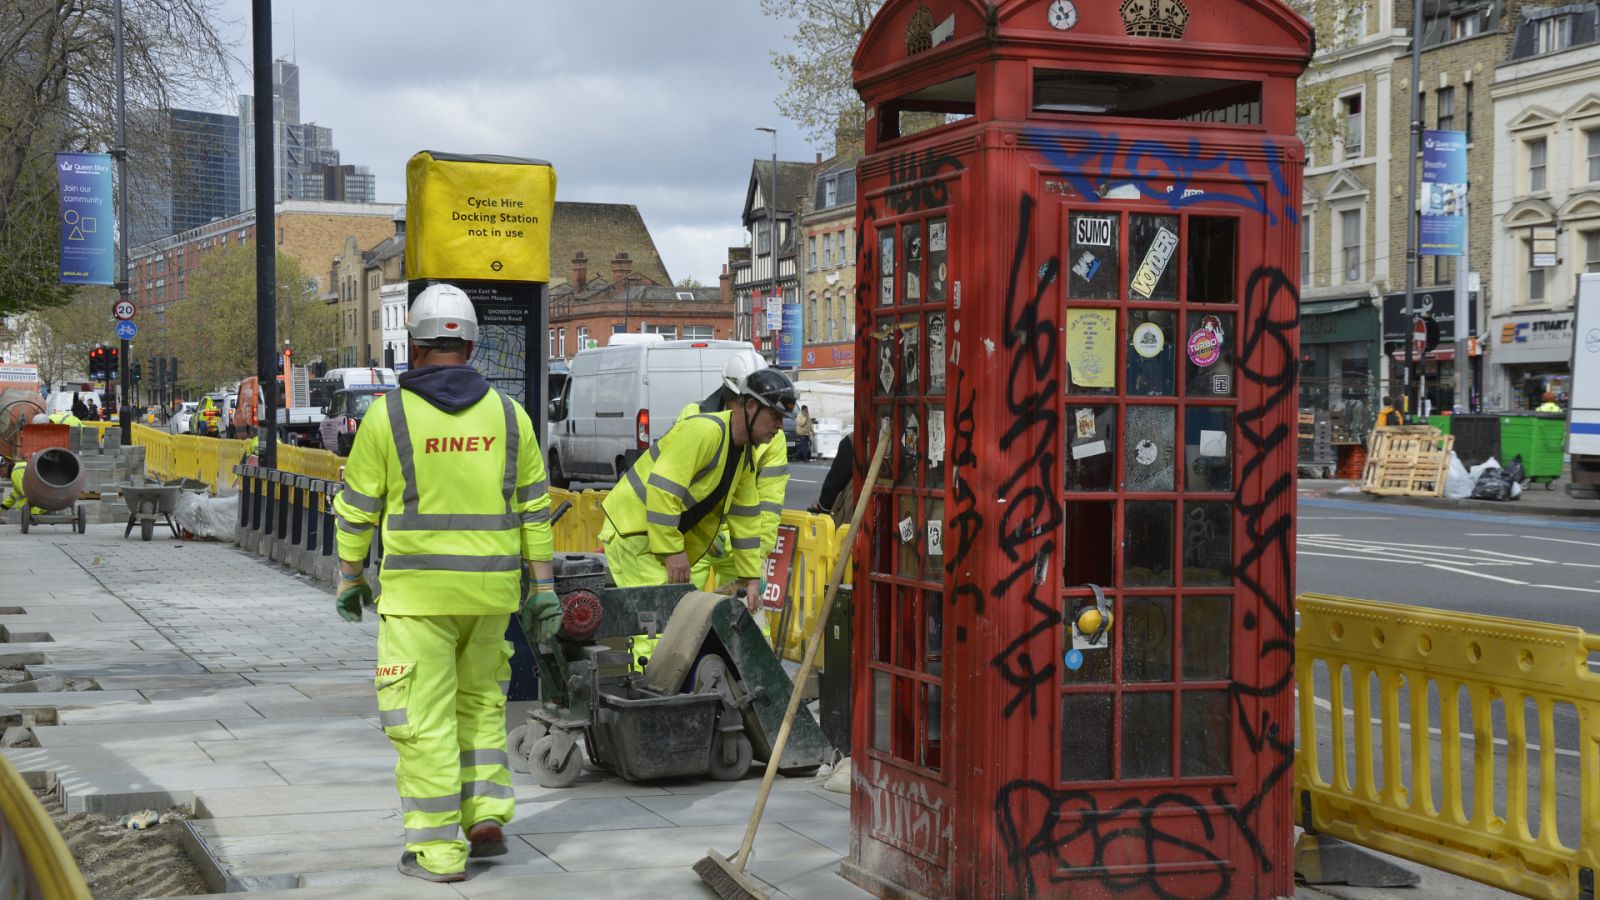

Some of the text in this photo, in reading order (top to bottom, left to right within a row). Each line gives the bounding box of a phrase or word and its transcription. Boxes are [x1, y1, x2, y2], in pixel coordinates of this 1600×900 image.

[74, 163, 108, 172] Queen Mary
[63, 184, 78, 192] Join
[63, 195, 103, 206] community
[467, 197, 524, 208] Cycle Hire
[452, 211, 538, 224] Docking Station
[468, 229, 488, 237] not
[491, 228, 501, 237] in
[1078, 219, 1110, 243] SUMO
[1132, 228, 1177, 296] VOYDER
[118, 305, 133, 315] 20
[1532, 320, 1570, 332] STUART
[1189, 338, 1218, 353] TURBO
[425, 436, 496, 454] RINEY
